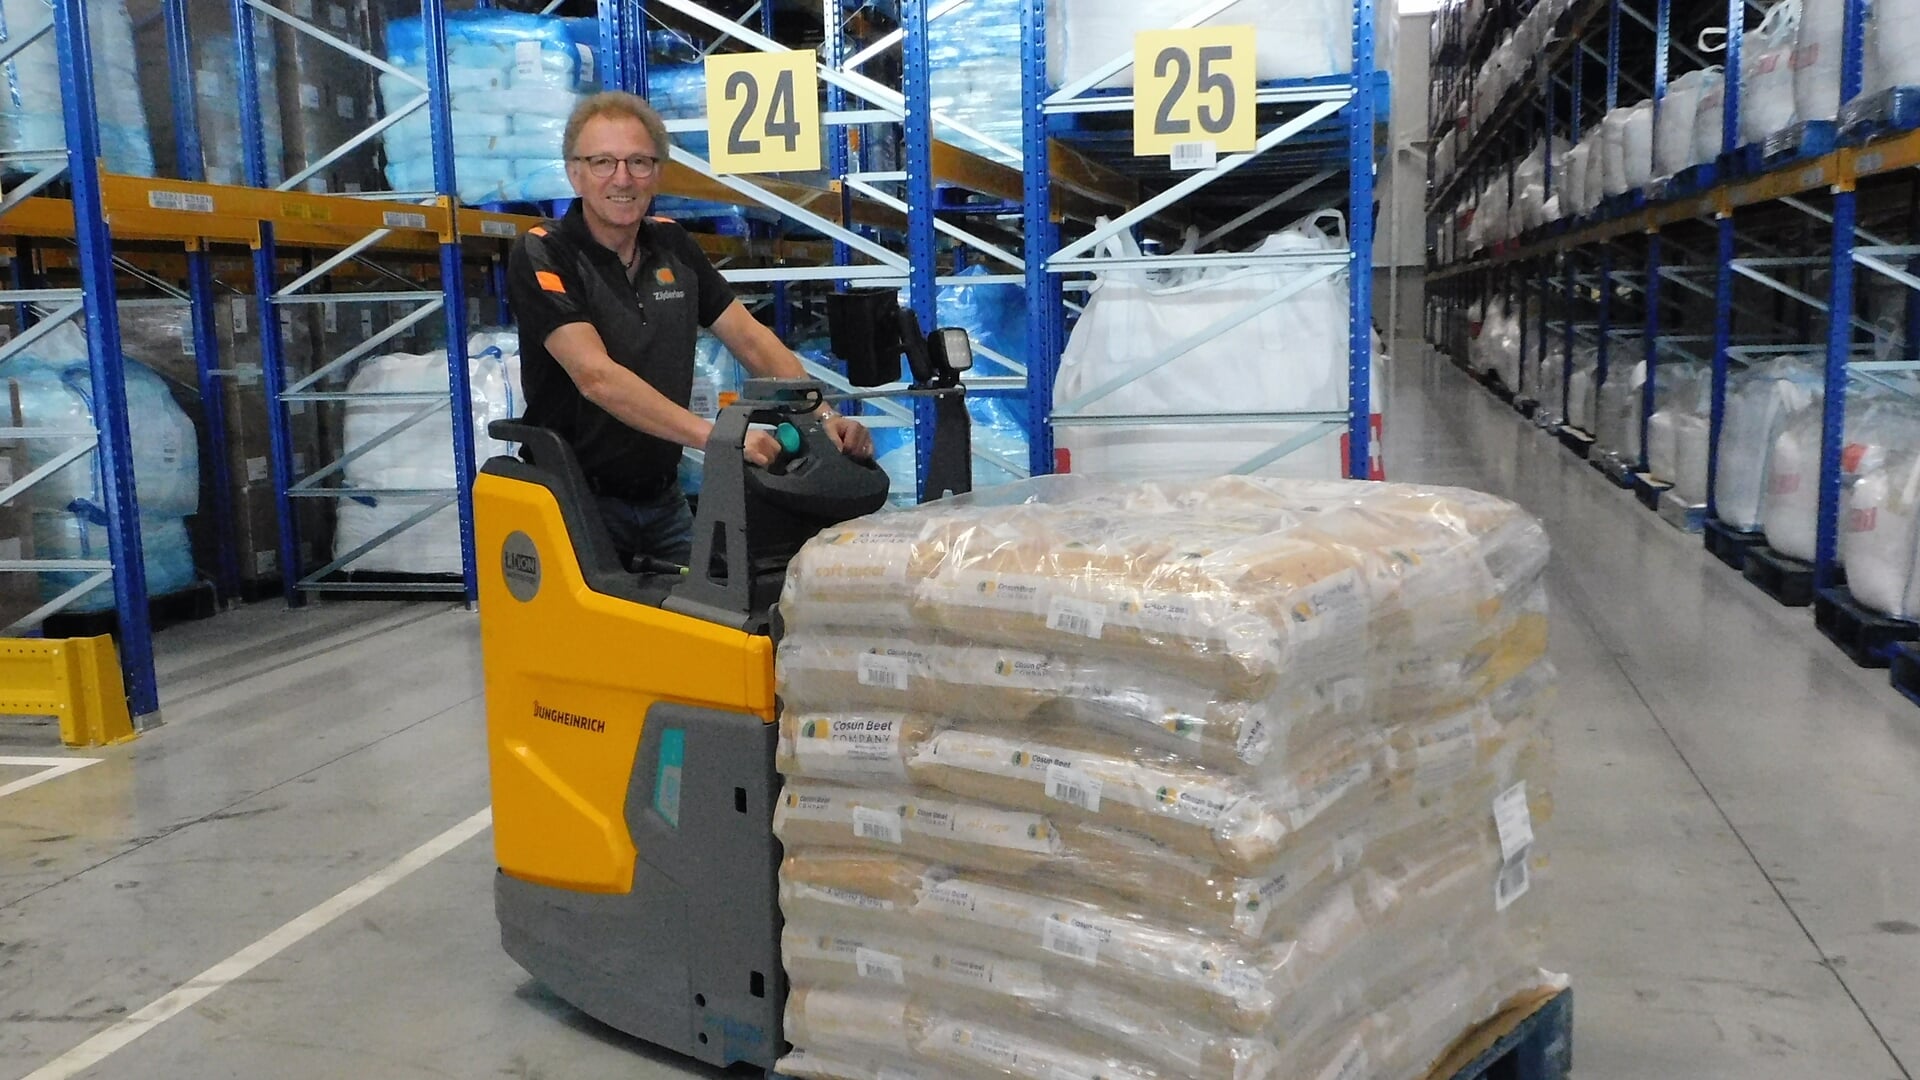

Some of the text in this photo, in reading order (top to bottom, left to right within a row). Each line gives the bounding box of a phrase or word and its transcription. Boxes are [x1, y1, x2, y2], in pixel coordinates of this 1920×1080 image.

[1154, 46, 1235, 134] 25
[725, 70, 800, 154] 24
[533, 699, 606, 733] JUNGHEINRICH
[832, 720, 893, 732] Cosun Beet
[832, 734, 890, 744] COMPANY
